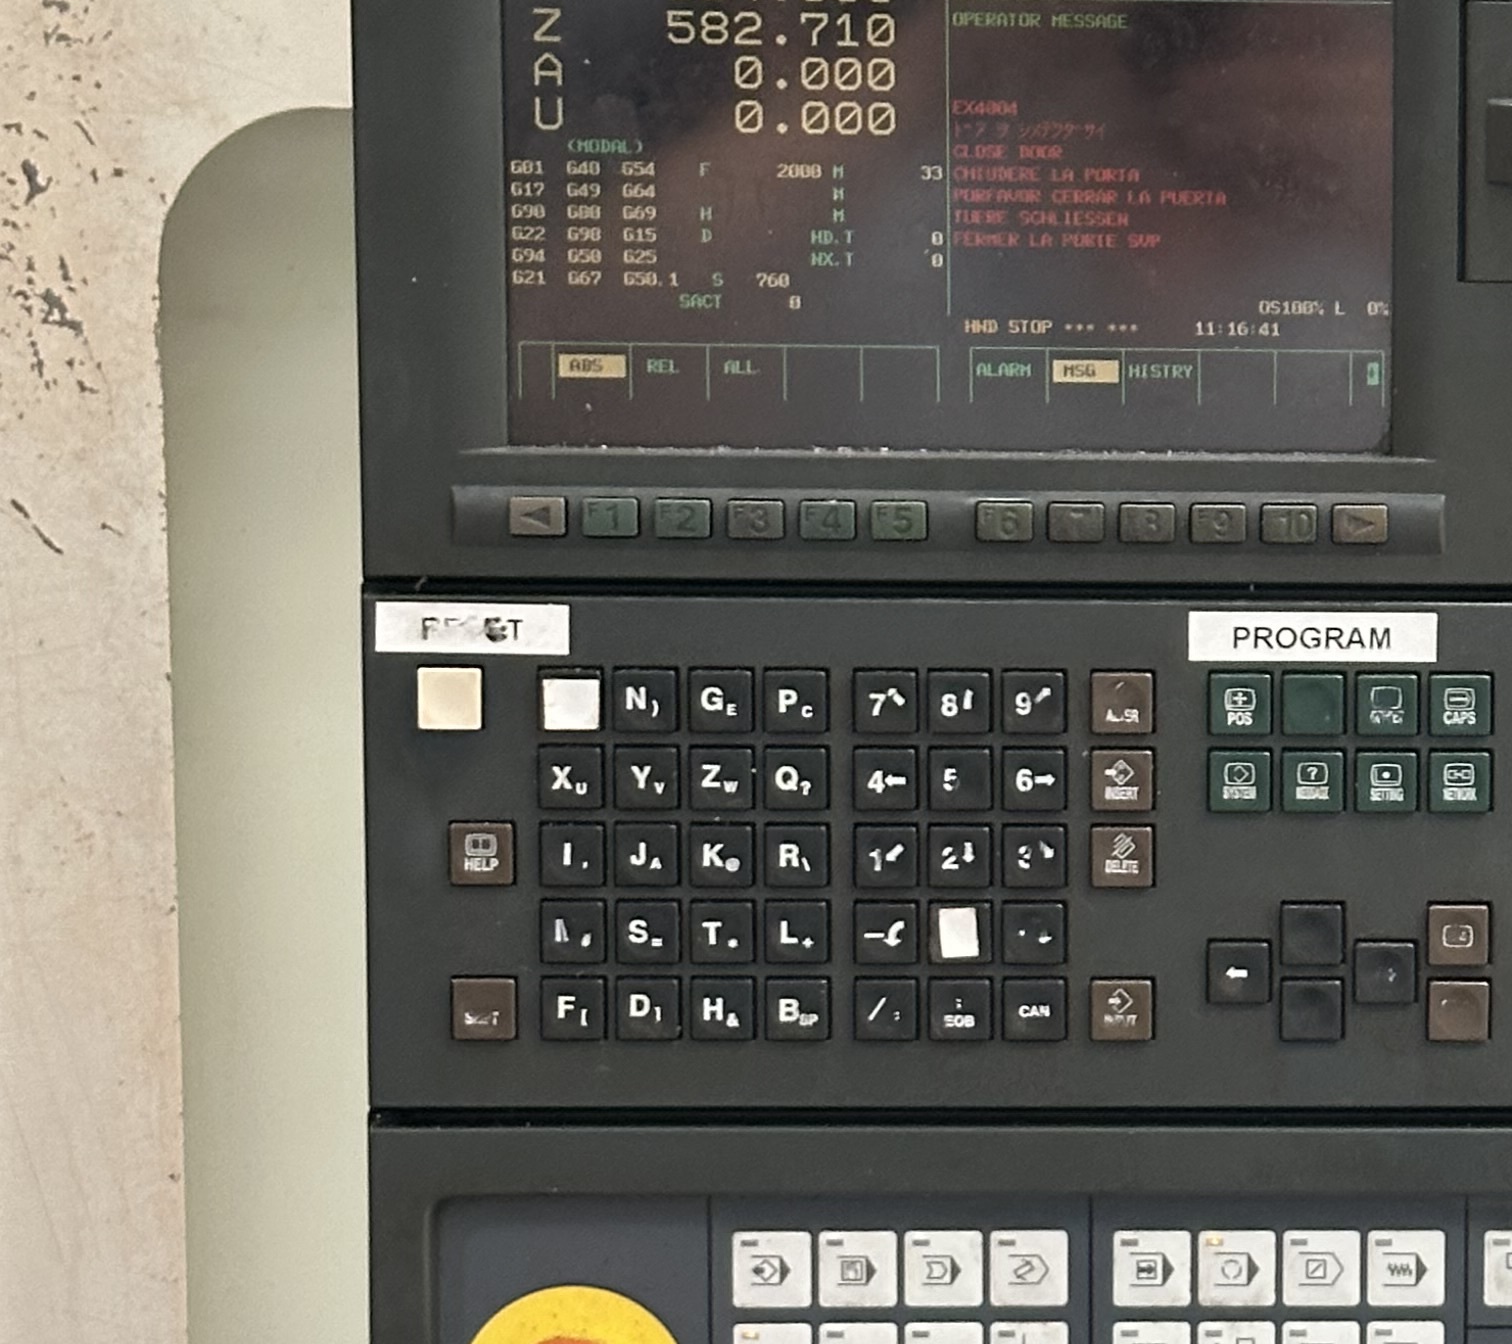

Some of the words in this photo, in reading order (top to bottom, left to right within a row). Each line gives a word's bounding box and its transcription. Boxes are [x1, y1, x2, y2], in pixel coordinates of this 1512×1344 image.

[533, 8, 561, 42] Z
[667, 11, 895, 46] 582.710
[953, 13, 1040, 28] OPERATOR
[1052, 14, 1127, 28] MESSAGE
[534, 53, 562, 86] A
[735, 56, 895, 90] 0.000
[534, 97, 563, 130] U
[735, 100, 895, 134] 0.000
[1195, 322, 1280, 336] 11:16:41
[723, 359, 757, 375] ALL
[976, 362, 1031, 379] ALARM
[1129, 364, 1193, 380] HISTRY
[1233, 627, 1391, 650] PROGRAM
[1227, 712, 1253, 726] POS
[1443, 711, 1475, 725] CAPS
